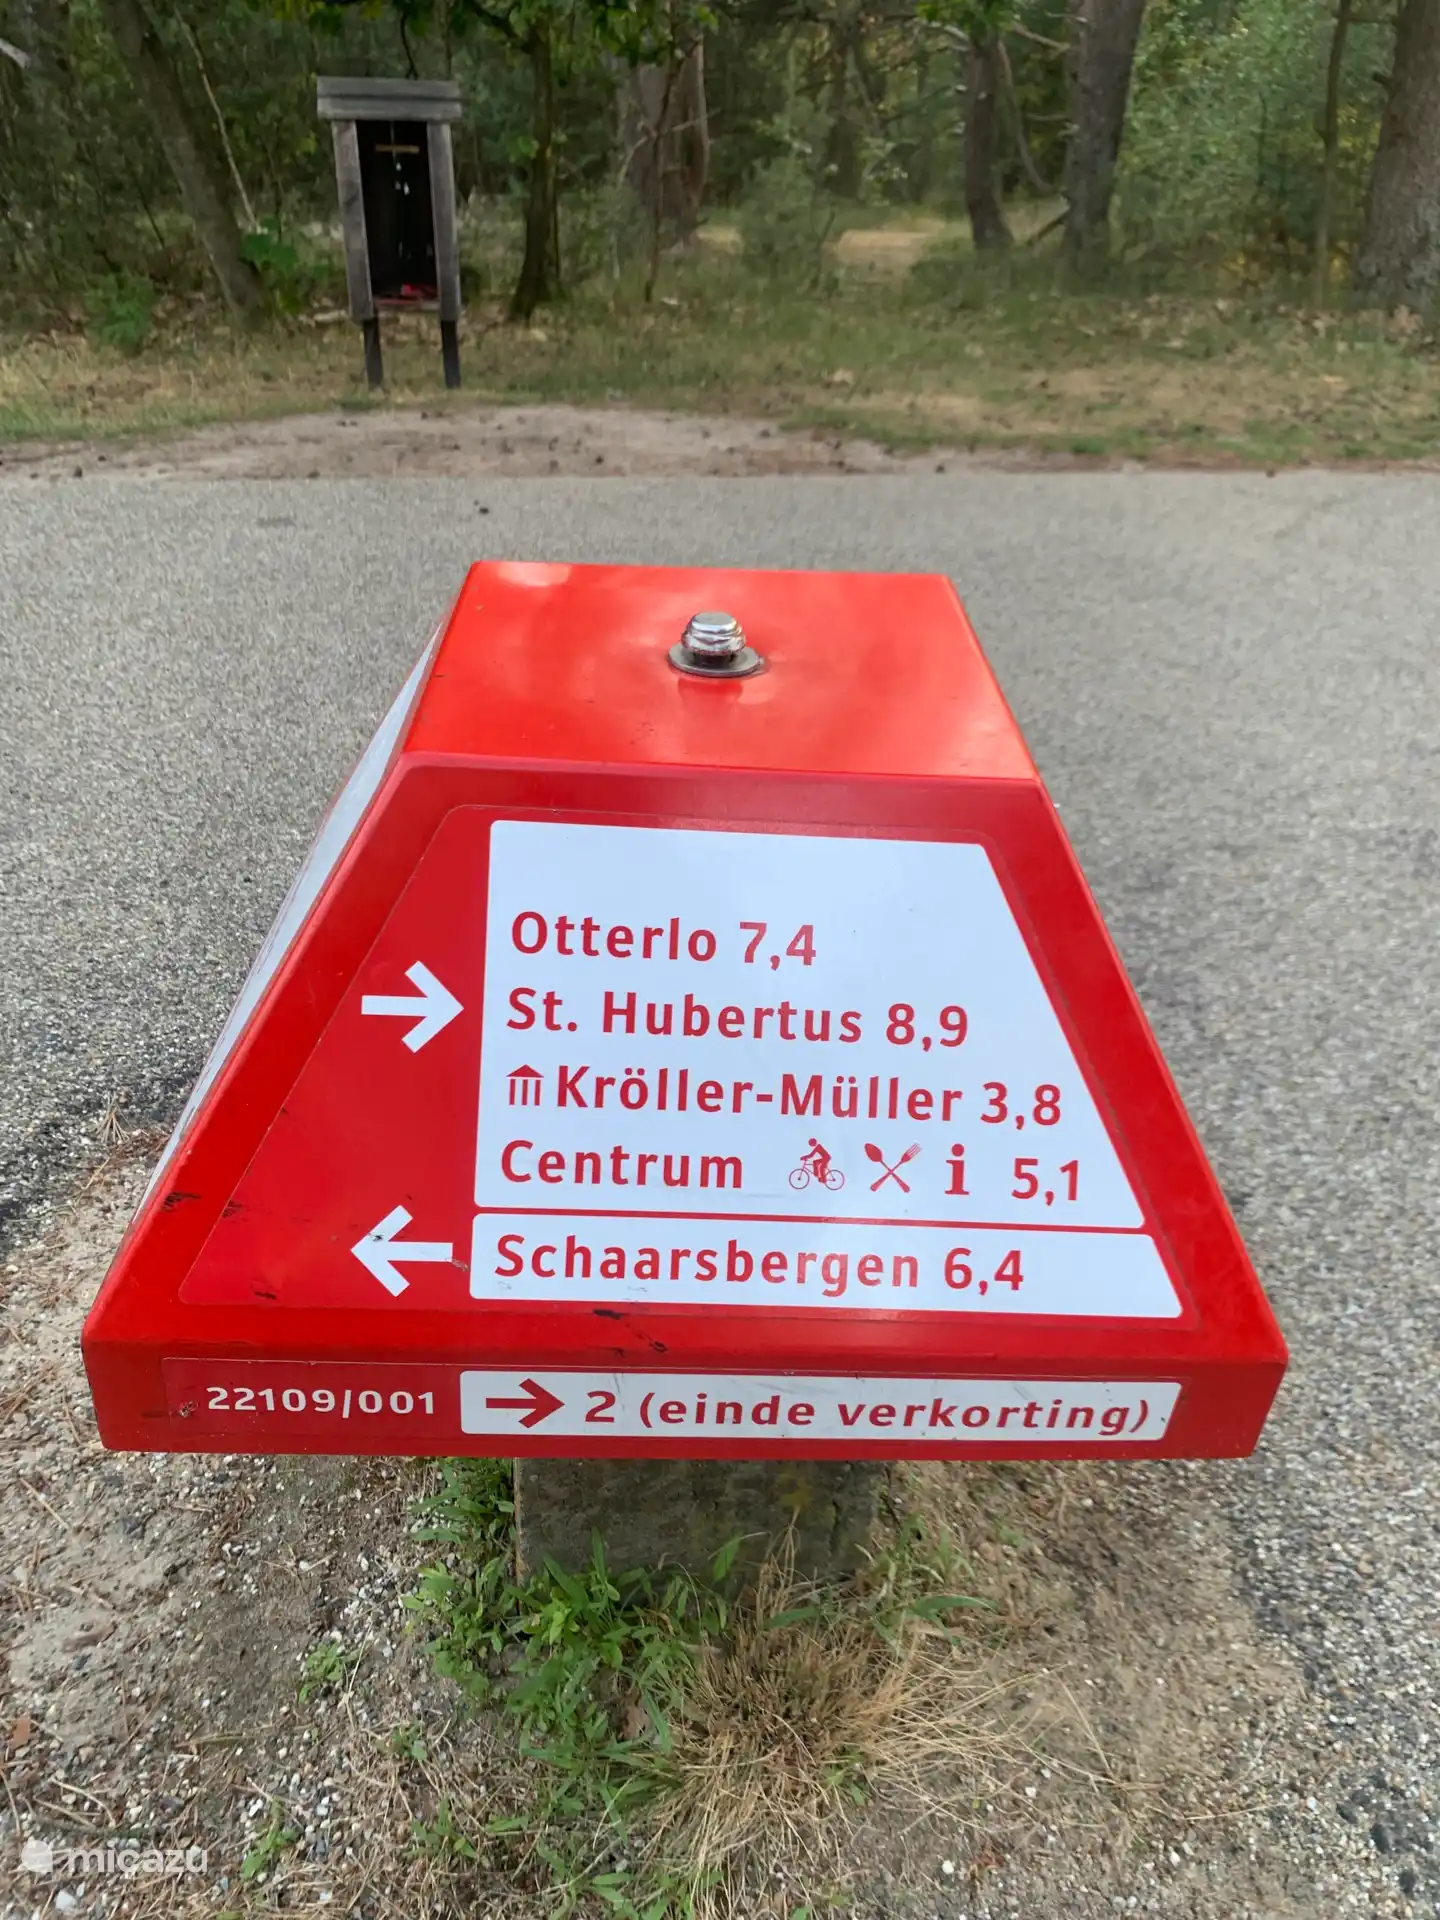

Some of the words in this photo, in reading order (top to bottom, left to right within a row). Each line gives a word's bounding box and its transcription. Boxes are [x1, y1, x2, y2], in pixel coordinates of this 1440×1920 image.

[512, 912, 716, 962] Otterlo
[740, 922, 815, 969] 7,4
[507, 987, 576, 1031] St.
[603, 991, 861, 1043] Hubertus
[886, 1004, 967, 1051] 8,9
[558, 1066, 962, 1120] Kröller-Müller
[981, 1082, 1061, 1129] 3,8
[501, 1140, 742, 1188] Centrum
[1012, 1158, 1078, 1205] 5,1
[496, 1234, 917, 1297] Schaarsbergen
[945, 1248, 1023, 1295] 6,4
[206, 1386, 434, 1419] 22109/001
[585, 1392, 615, 1422] 2
[640, 1393, 814, 1427] (einde
[837, 1398, 1148, 1436] verkorting)
